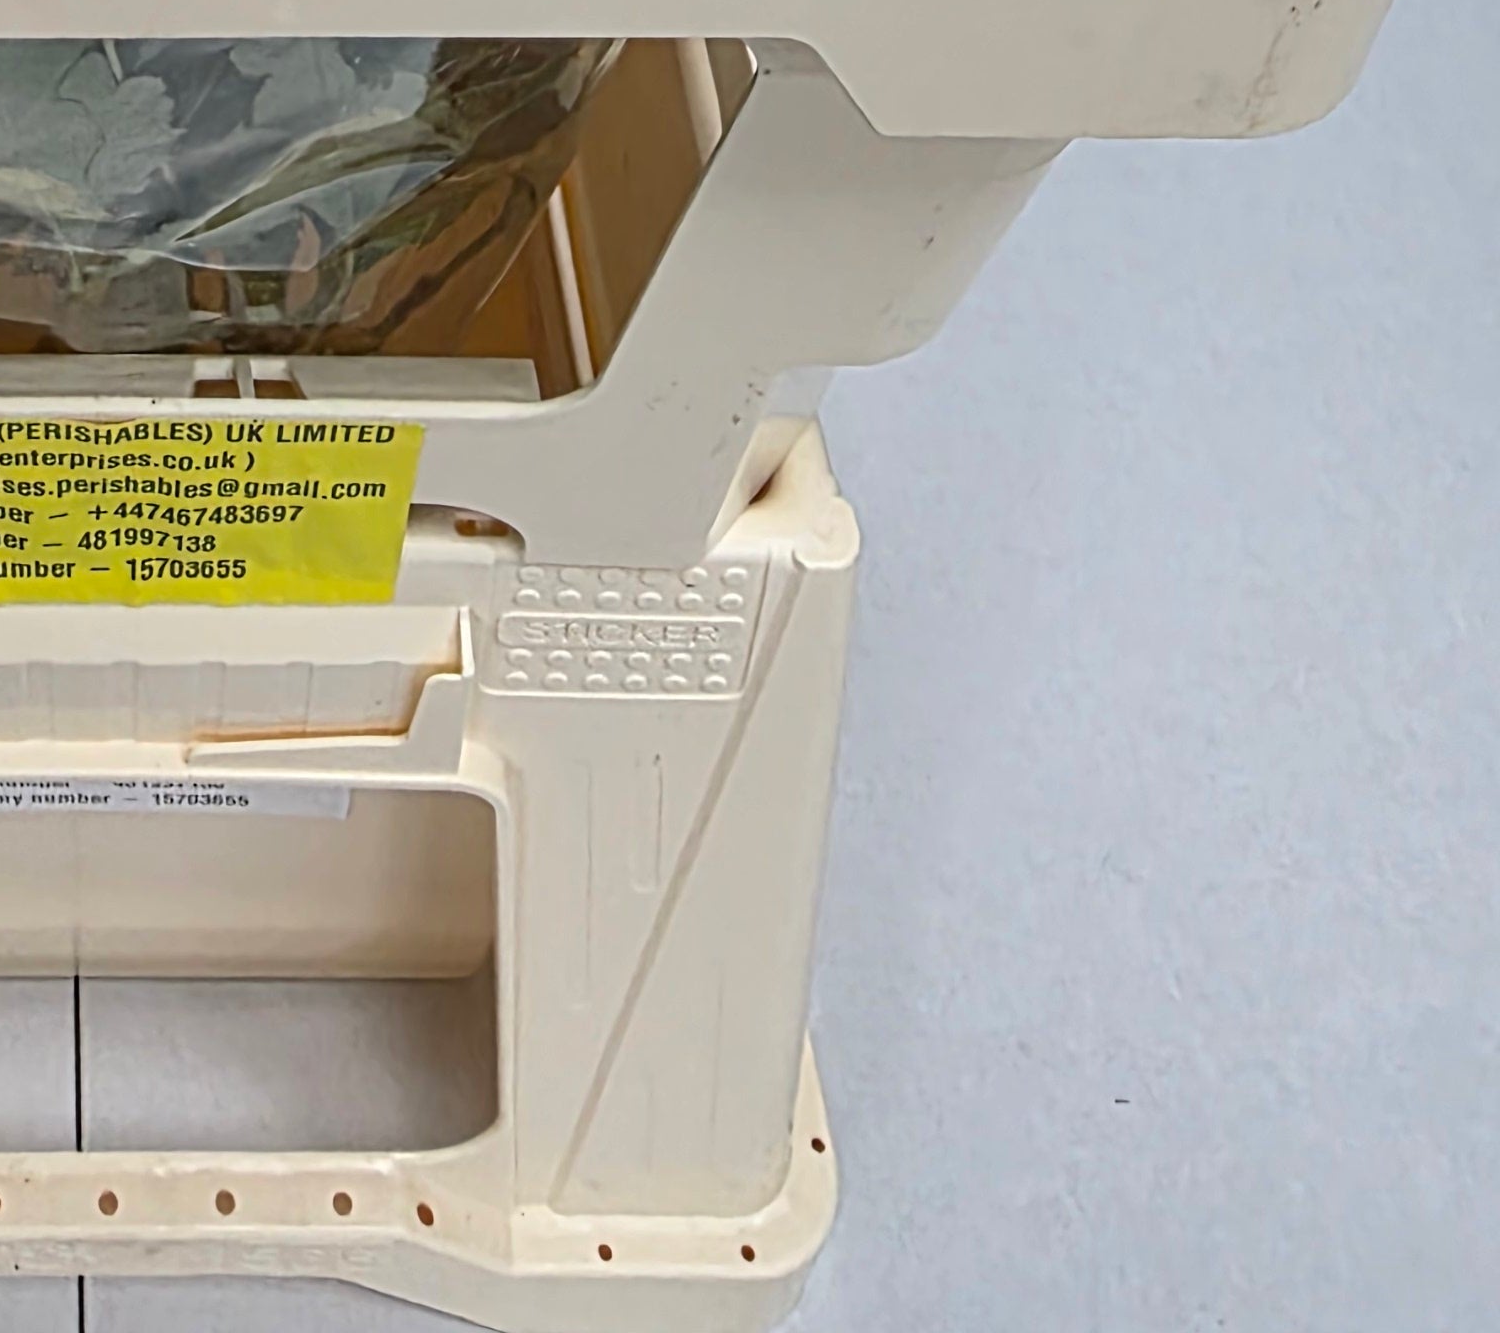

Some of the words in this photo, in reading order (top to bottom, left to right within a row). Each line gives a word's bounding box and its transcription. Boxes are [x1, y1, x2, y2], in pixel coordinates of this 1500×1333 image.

[226, 423, 263, 444] UK
[277, 424, 395, 444] LIMITED
[88, 502, 304, 526] +447467483697
[77, 528, 216, 553] 481997138
[126, 557, 247, 581] 15703655
[31, 791, 111, 805] number
